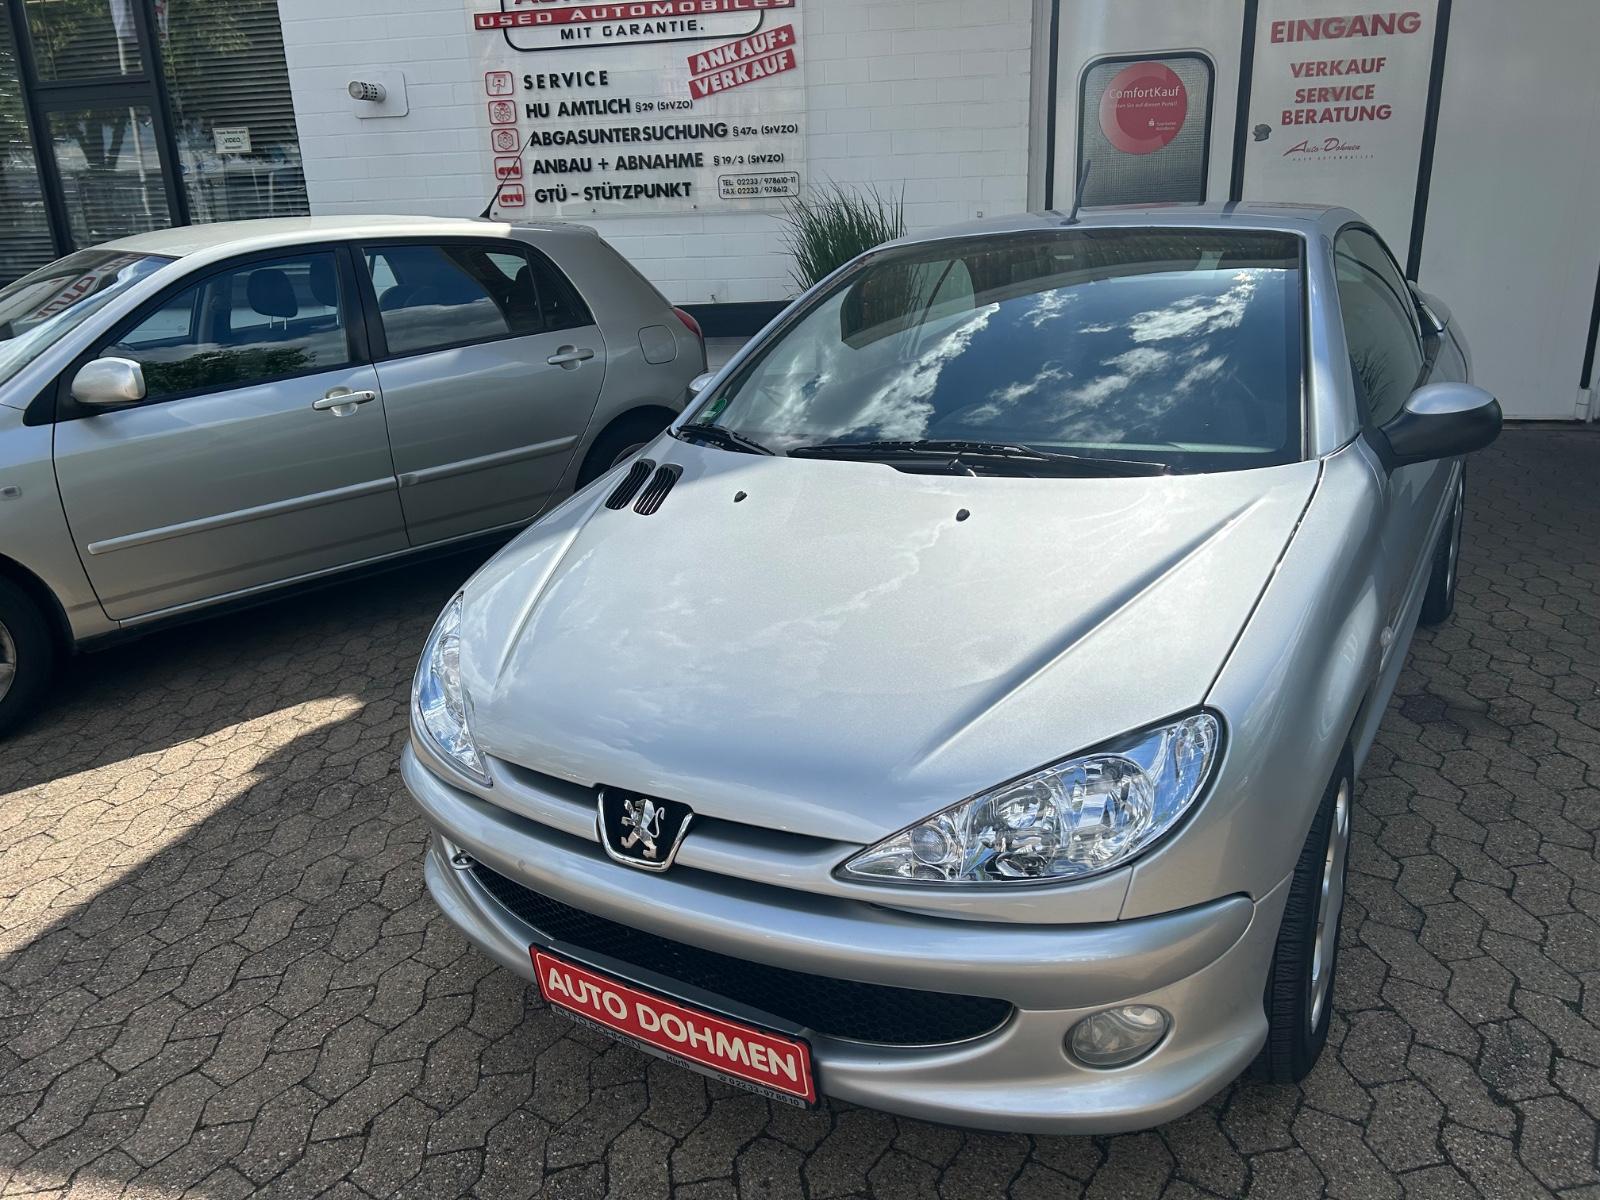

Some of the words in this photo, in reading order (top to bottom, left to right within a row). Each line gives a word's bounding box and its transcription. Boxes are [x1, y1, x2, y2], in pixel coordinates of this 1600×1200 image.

[479, 12, 553, 27] USED
[561, 26, 592, 40] MIT
[602, 19, 704, 37] GARANTIE.
[1270, 12, 1422, 43] EINGANG
[695, 52, 788, 95] VERKAUF
[1290, 57, 1387, 78] VERKAUF
[523, 70, 609, 90] SERVICE
[1109, 86, 1180, 99] ComfortKauf
[1294, 84, 1376, 104] SERVICE
[526, 102, 550, 118] HU
[557, 98, 631, 116] AMTLICH
[657, 99, 693, 111] (StVZO)
[1281, 104, 1392, 125] BERATUNG
[529, 122, 728, 147] ABGASUNTERSUCHUNG
[761, 124, 798, 135] (StVZO)
[532, 157, 592, 174] ANBAU
[598, 158, 609, 170] +
[615, 152, 704, 171] ABNAHME
[747, 153, 785, 164] (StVZO)
[534, 183, 567, 203] GTÜ
[583, 182, 692, 201] STÜTZPUNKT
[548, 967, 628, 1020] AUTO
[636, 1002, 798, 1082] DOHMEN
